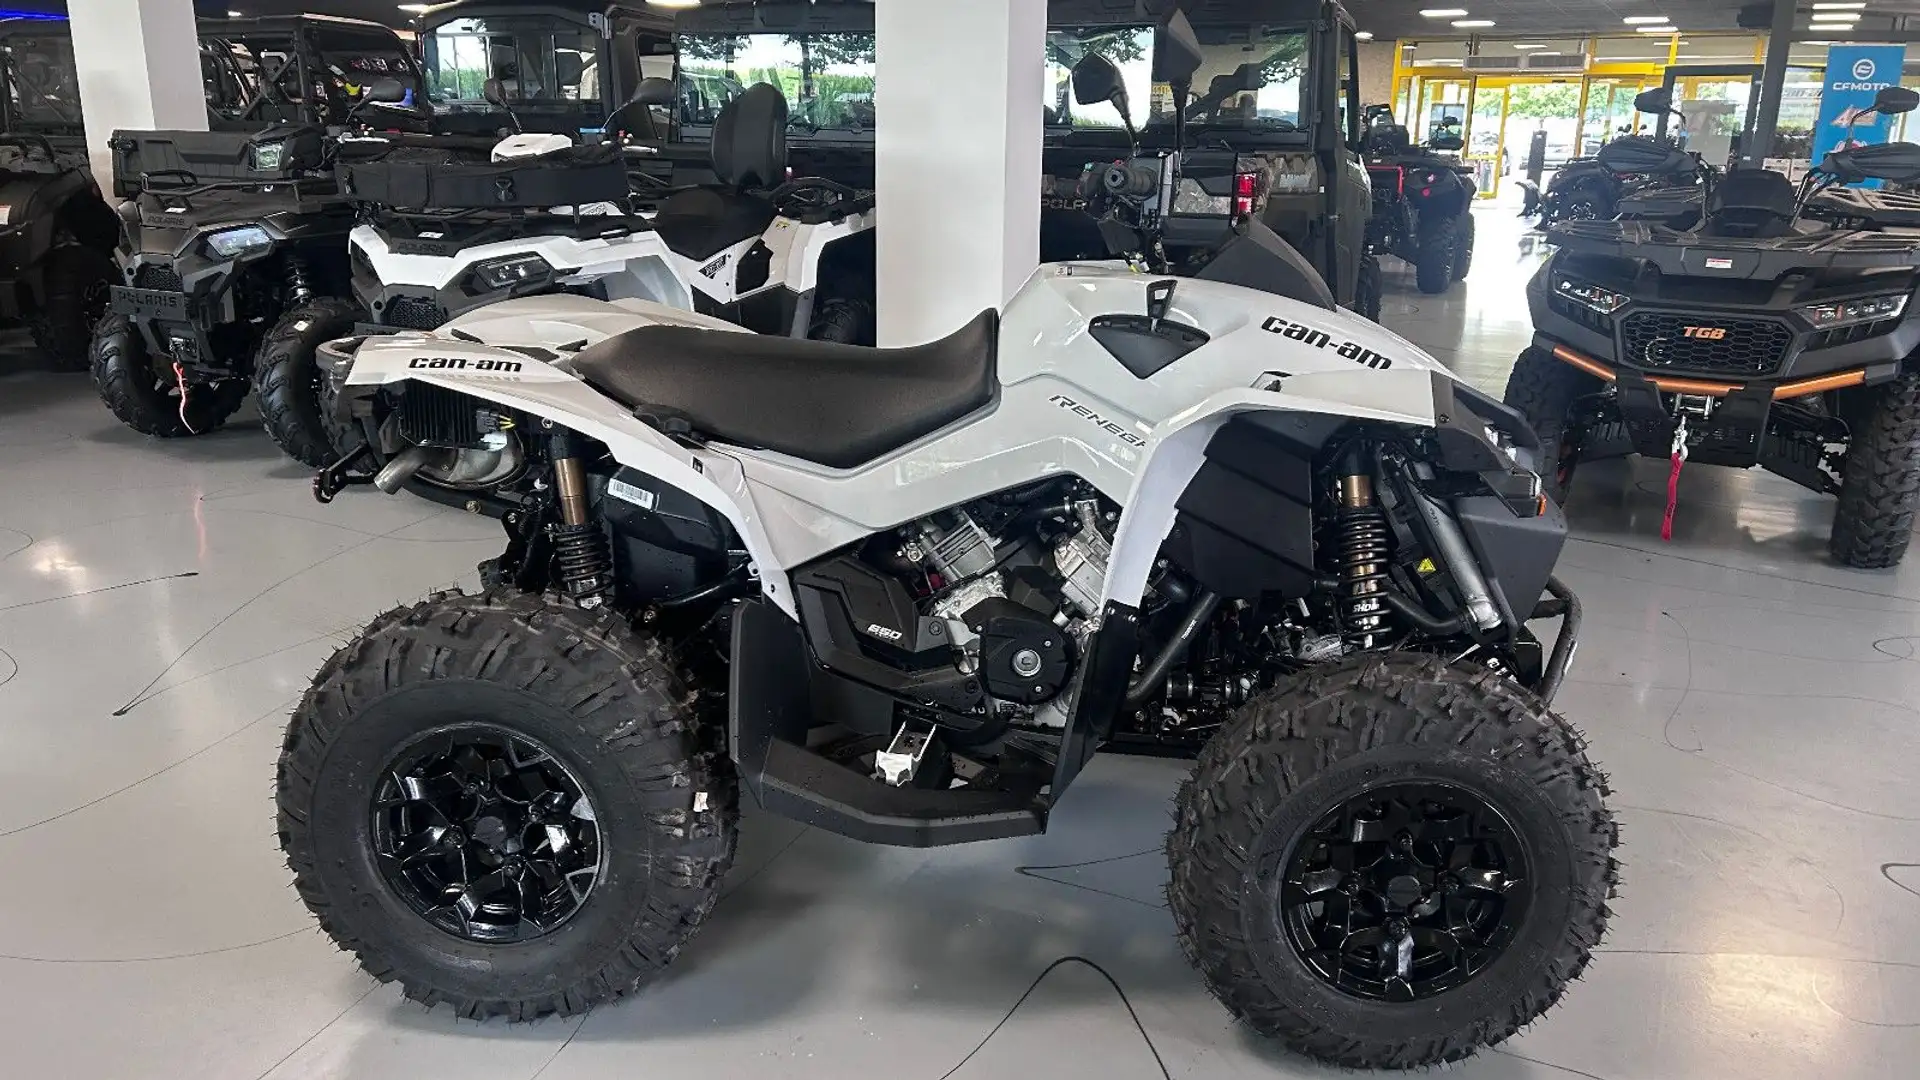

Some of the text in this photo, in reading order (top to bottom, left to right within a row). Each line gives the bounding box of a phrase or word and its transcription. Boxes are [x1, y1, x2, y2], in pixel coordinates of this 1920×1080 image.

[118, 290, 178, 307] POLARIS
[1683, 326, 1726, 340] TGB
[1261, 316, 1392, 370] can-am
[408, 357, 522, 373] can-am
[867, 623, 902, 640] 650
